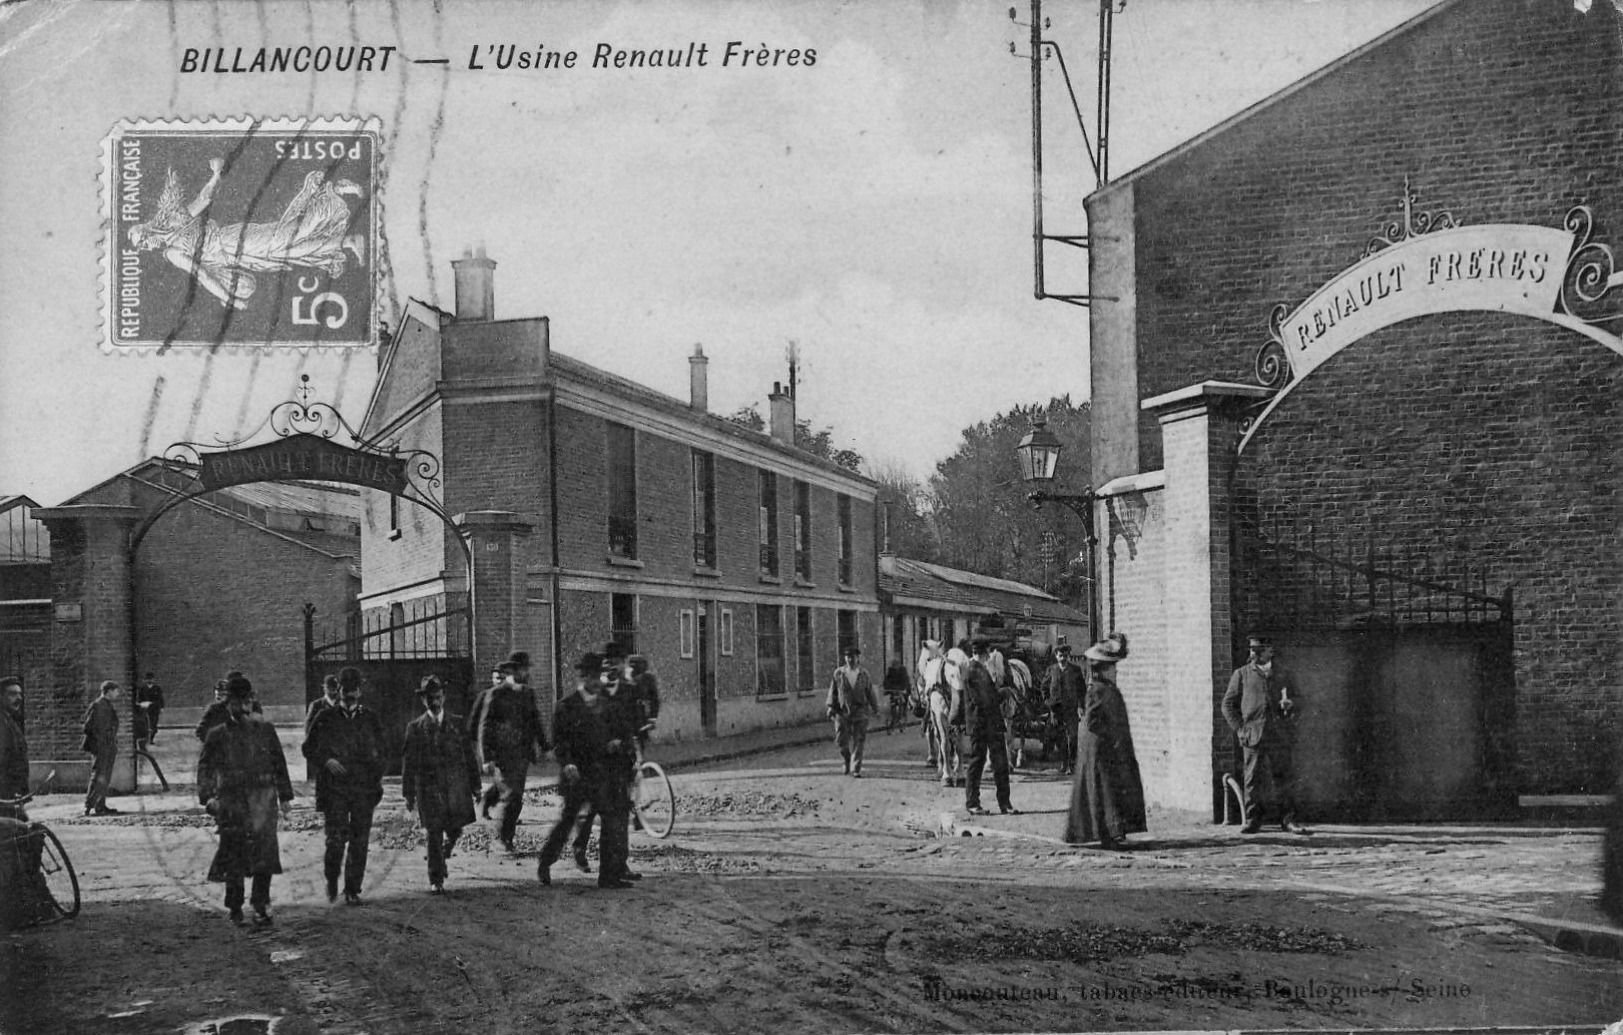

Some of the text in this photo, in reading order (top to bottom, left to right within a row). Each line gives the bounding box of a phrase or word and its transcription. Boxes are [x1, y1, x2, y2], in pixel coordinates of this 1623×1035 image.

[275, 140, 362, 160] POSTES
[121, 138, 142, 223] FRANÇAISE
[1297, 262, 1406, 351] RENAULT
[211, 451, 308, 482] RENAULT
